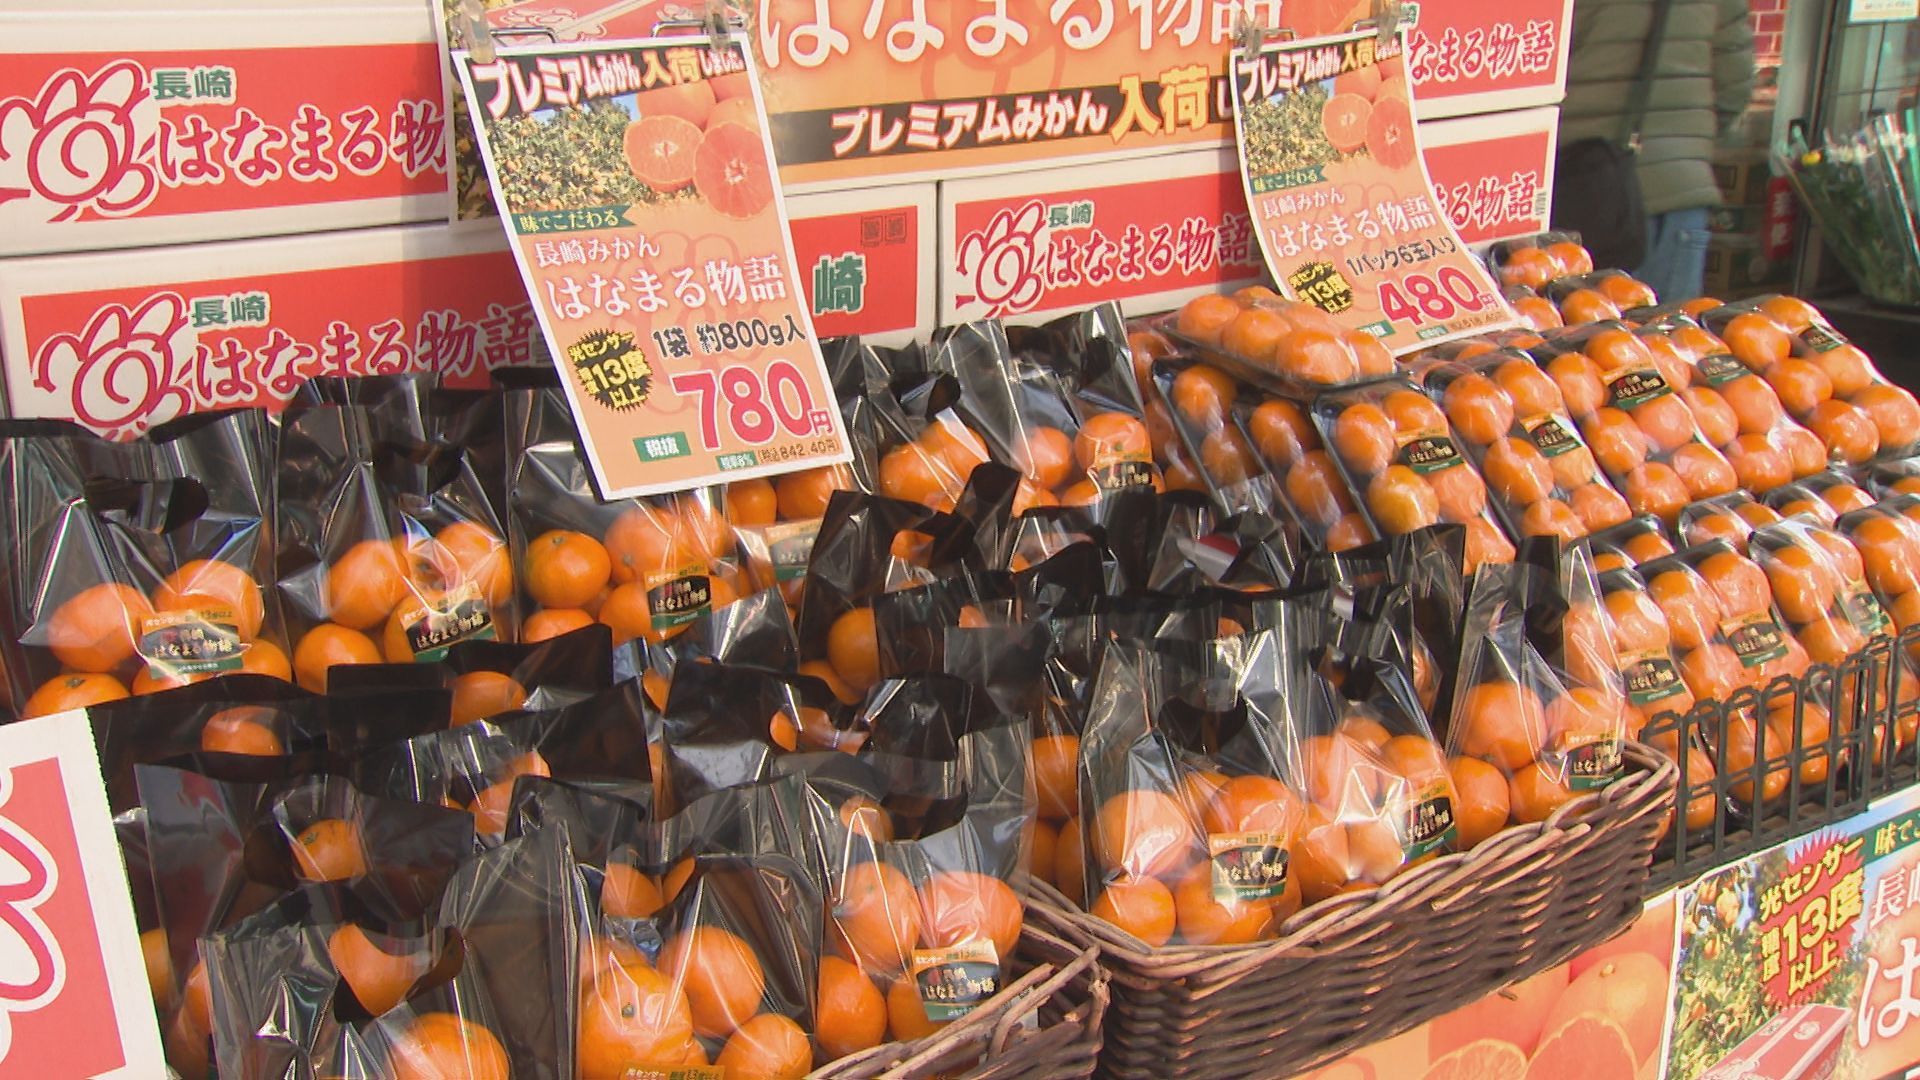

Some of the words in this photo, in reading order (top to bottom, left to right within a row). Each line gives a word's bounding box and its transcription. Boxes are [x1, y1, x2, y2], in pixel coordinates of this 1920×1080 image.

[153, 69, 232, 101] 長崎
[1050, 203, 1093, 228] 長崎
[1262, 187, 1345, 220] 長崎みかん
[1269, 195, 1437, 258] はなまる物語
[534, 233, 661, 269] 長崎みかん
[1046, 215, 1250, 287] はなまる物語
[191, 294, 267, 328] 長崎
[545, 253, 788, 320] はなまる物語
[814, 254, 865, 315] 崎
[194, 303, 534, 399] はなまる物語
[567, 331, 634, 362] 光センサー
[591, 349, 652, 390] 13度
[653, 326, 692, 360] 1袋
[671, 361, 835, 450] 780円
[1760, 837, 1865, 922] 光センサー
[1782, 867, 1865, 955] 13度
[1788, 938, 1841, 997] 以上
